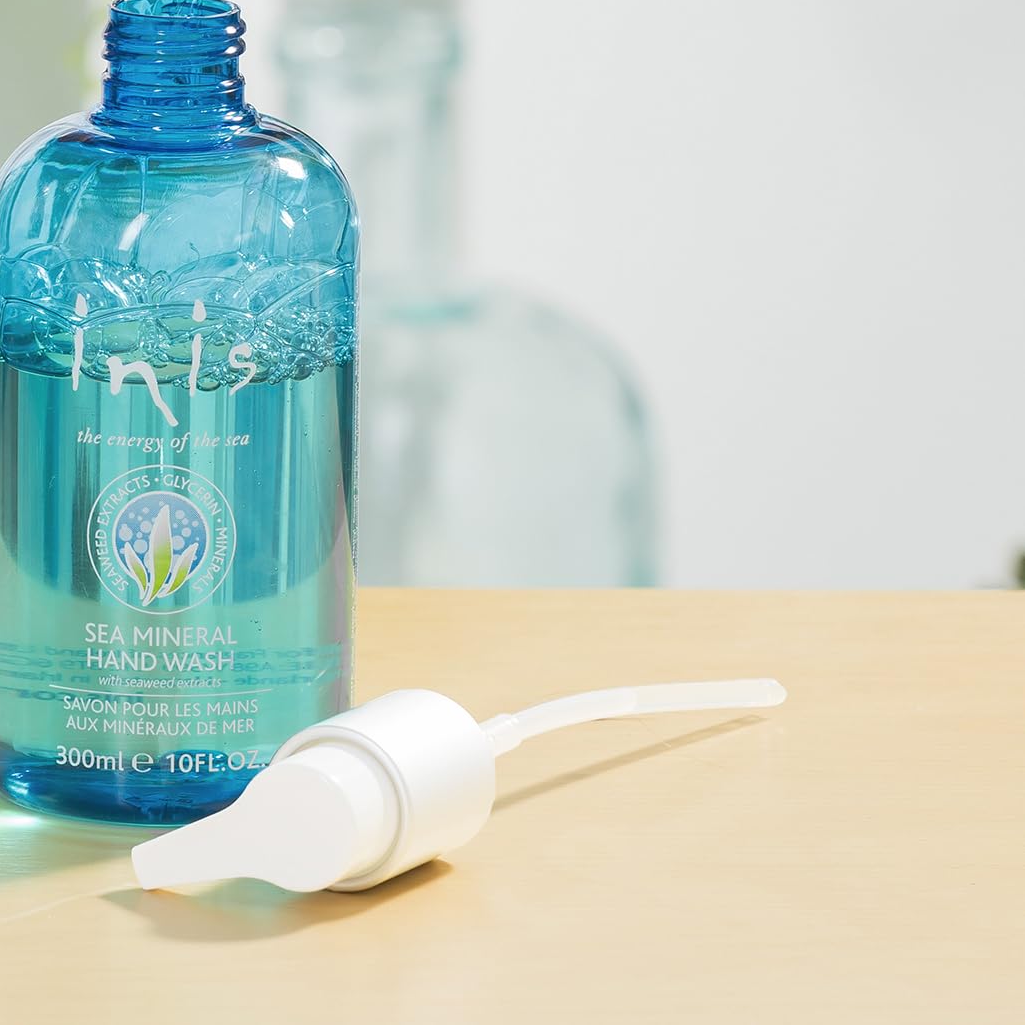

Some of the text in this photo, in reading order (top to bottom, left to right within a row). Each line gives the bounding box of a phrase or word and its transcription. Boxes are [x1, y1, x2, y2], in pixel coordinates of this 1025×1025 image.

[72, 293, 257, 427] inis
[77, 427, 250, 453] the energy of the sea
[95, 474, 228, 593] SEAWEED EXTRACTS GLYCERIN MINERALS
[84, 622, 238, 647] SEA MINERAL
[86, 647, 158, 672] HAND
[162, 649, 235, 673] WASH
[98, 675, 123, 687] with
[124, 677, 175, 689] seaweed
[176, 676, 222, 688] extracts
[63, 696, 259, 717] SAVON POUR LES MAINS
[65, 716, 255, 736] AUX MINÉRAUX DE MER
[54, 745, 125, 772] 300ml
